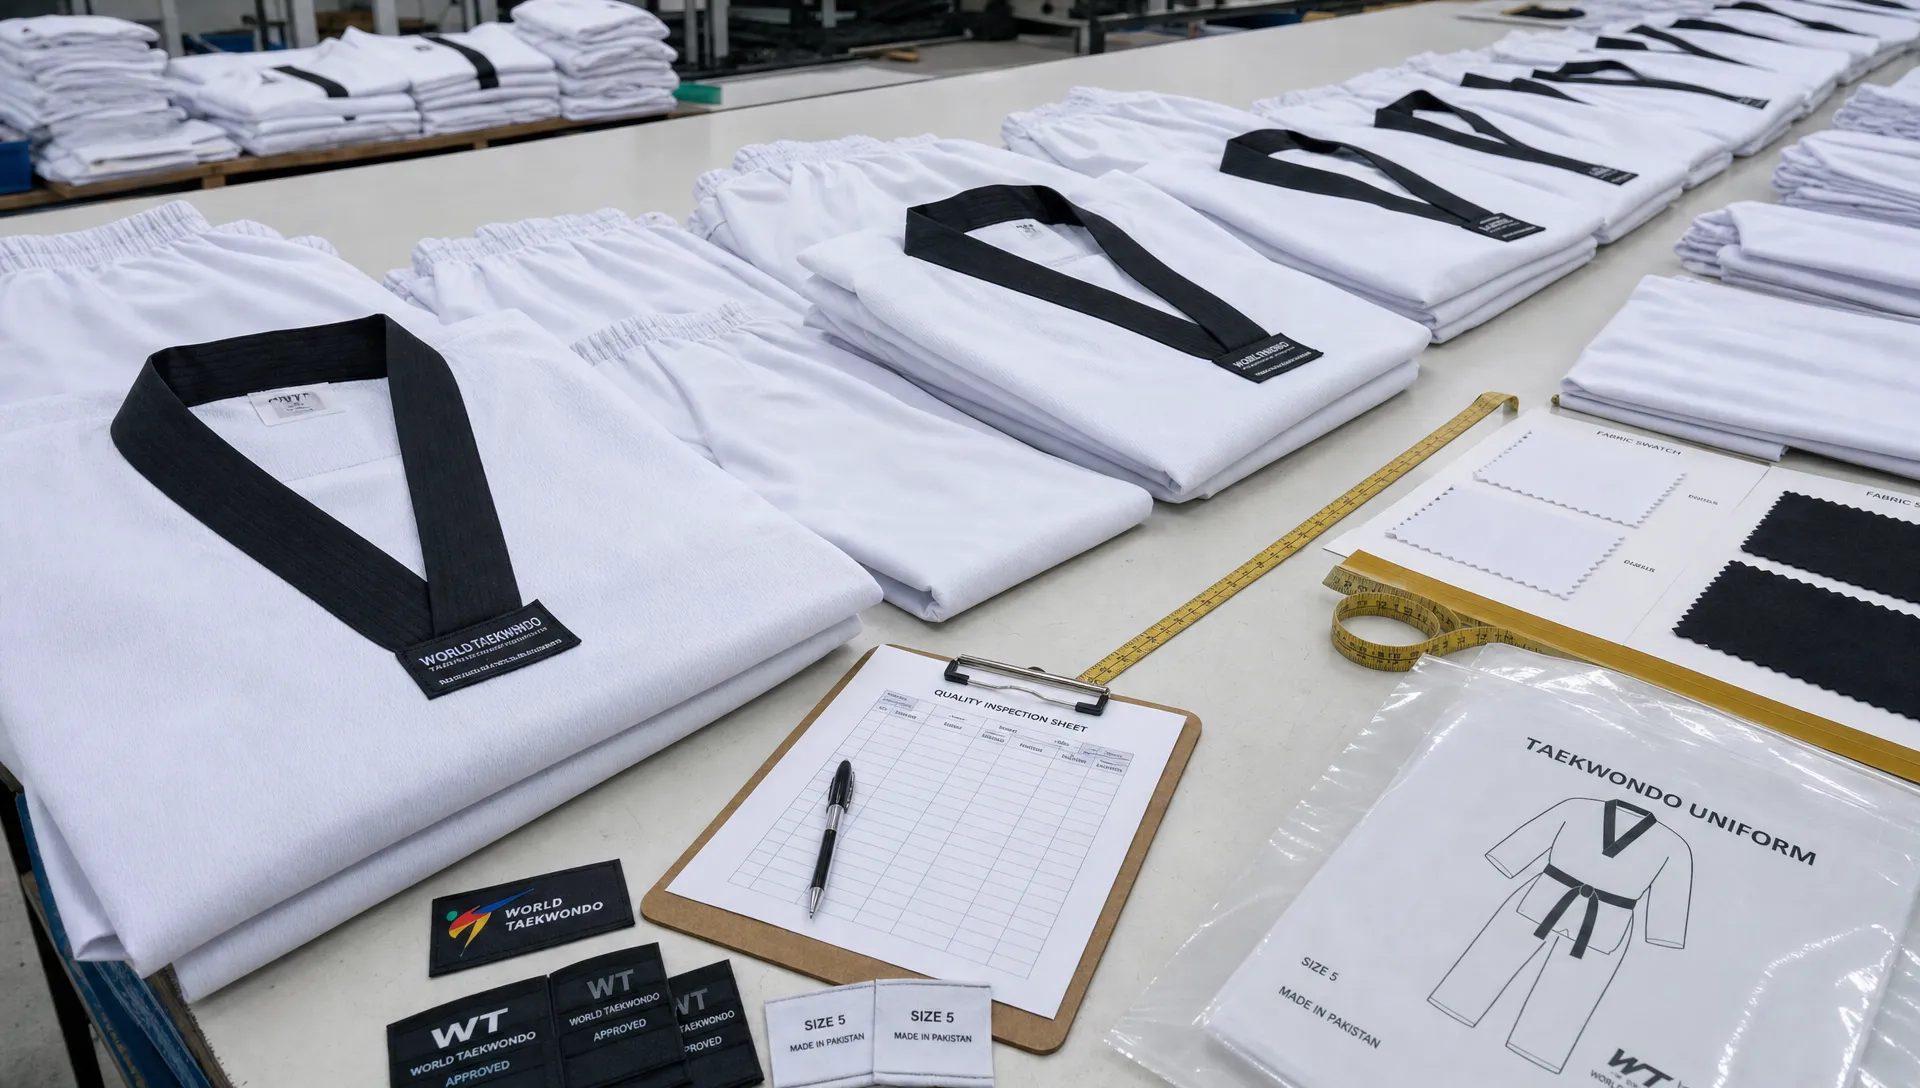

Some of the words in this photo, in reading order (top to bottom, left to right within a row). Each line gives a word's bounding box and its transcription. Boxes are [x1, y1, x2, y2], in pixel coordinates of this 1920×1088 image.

[1596, 430, 1634, 444] FABRIC
[1635, 440, 1681, 455] SWATCH
[1866, 491, 1911, 506] FABRIC
[418, 642, 473, 667] WORLD
[934, 688, 983, 706] QUALITY
[983, 701, 1049, 724] INSPECTION
[1050, 718, 1089, 734] SHEET
[1526, 737, 1683, 808] TAEKWONDO
[1688, 803, 1817, 866] UNIFORM
[505, 898, 562, 919] WORLD
[505, 901, 604, 931] TAEKWONDO
[1301, 956, 1329, 976] SIZE
[1329, 971, 1339, 981] 5
[586, 968, 634, 1000] WT
[569, 1009, 603, 1027] WORLD
[603, 992, 660, 1016] TAEKWONDO
[679, 1010, 735, 1034] TAEKWONDO
[910, 1010, 942, 1022] SIZE
[946, 1012, 954, 1023] 5
[1278, 985, 1313, 1011] MADE
[1312, 1005, 1327, 1018] IN
[1326, 1013, 1382, 1049] PAKISTAN
[430, 1007, 508, 1049] WT
[593, 1018, 647, 1042] APPROVED
[804, 1016, 834, 1031] SIZE
[838, 1014, 846, 1026] 5
[684, 1036, 722, 1053] PROVED
[789, 1041, 814, 1052] MADE
[816, 1040, 825, 1048] IN
[826, 1032, 865, 1047] PAKISTAN
[894, 1032, 919, 1041] MADE
[921, 1033, 930, 1041] IN
[932, 1033, 972, 1043] PAKISTAN
[410, 1055, 454, 1077] WORLD
[456, 1031, 536, 1062] TAEKWONDO
[445, 1060, 511, 1088] APPROVED
[1607, 1048, 1674, 1088] WT
